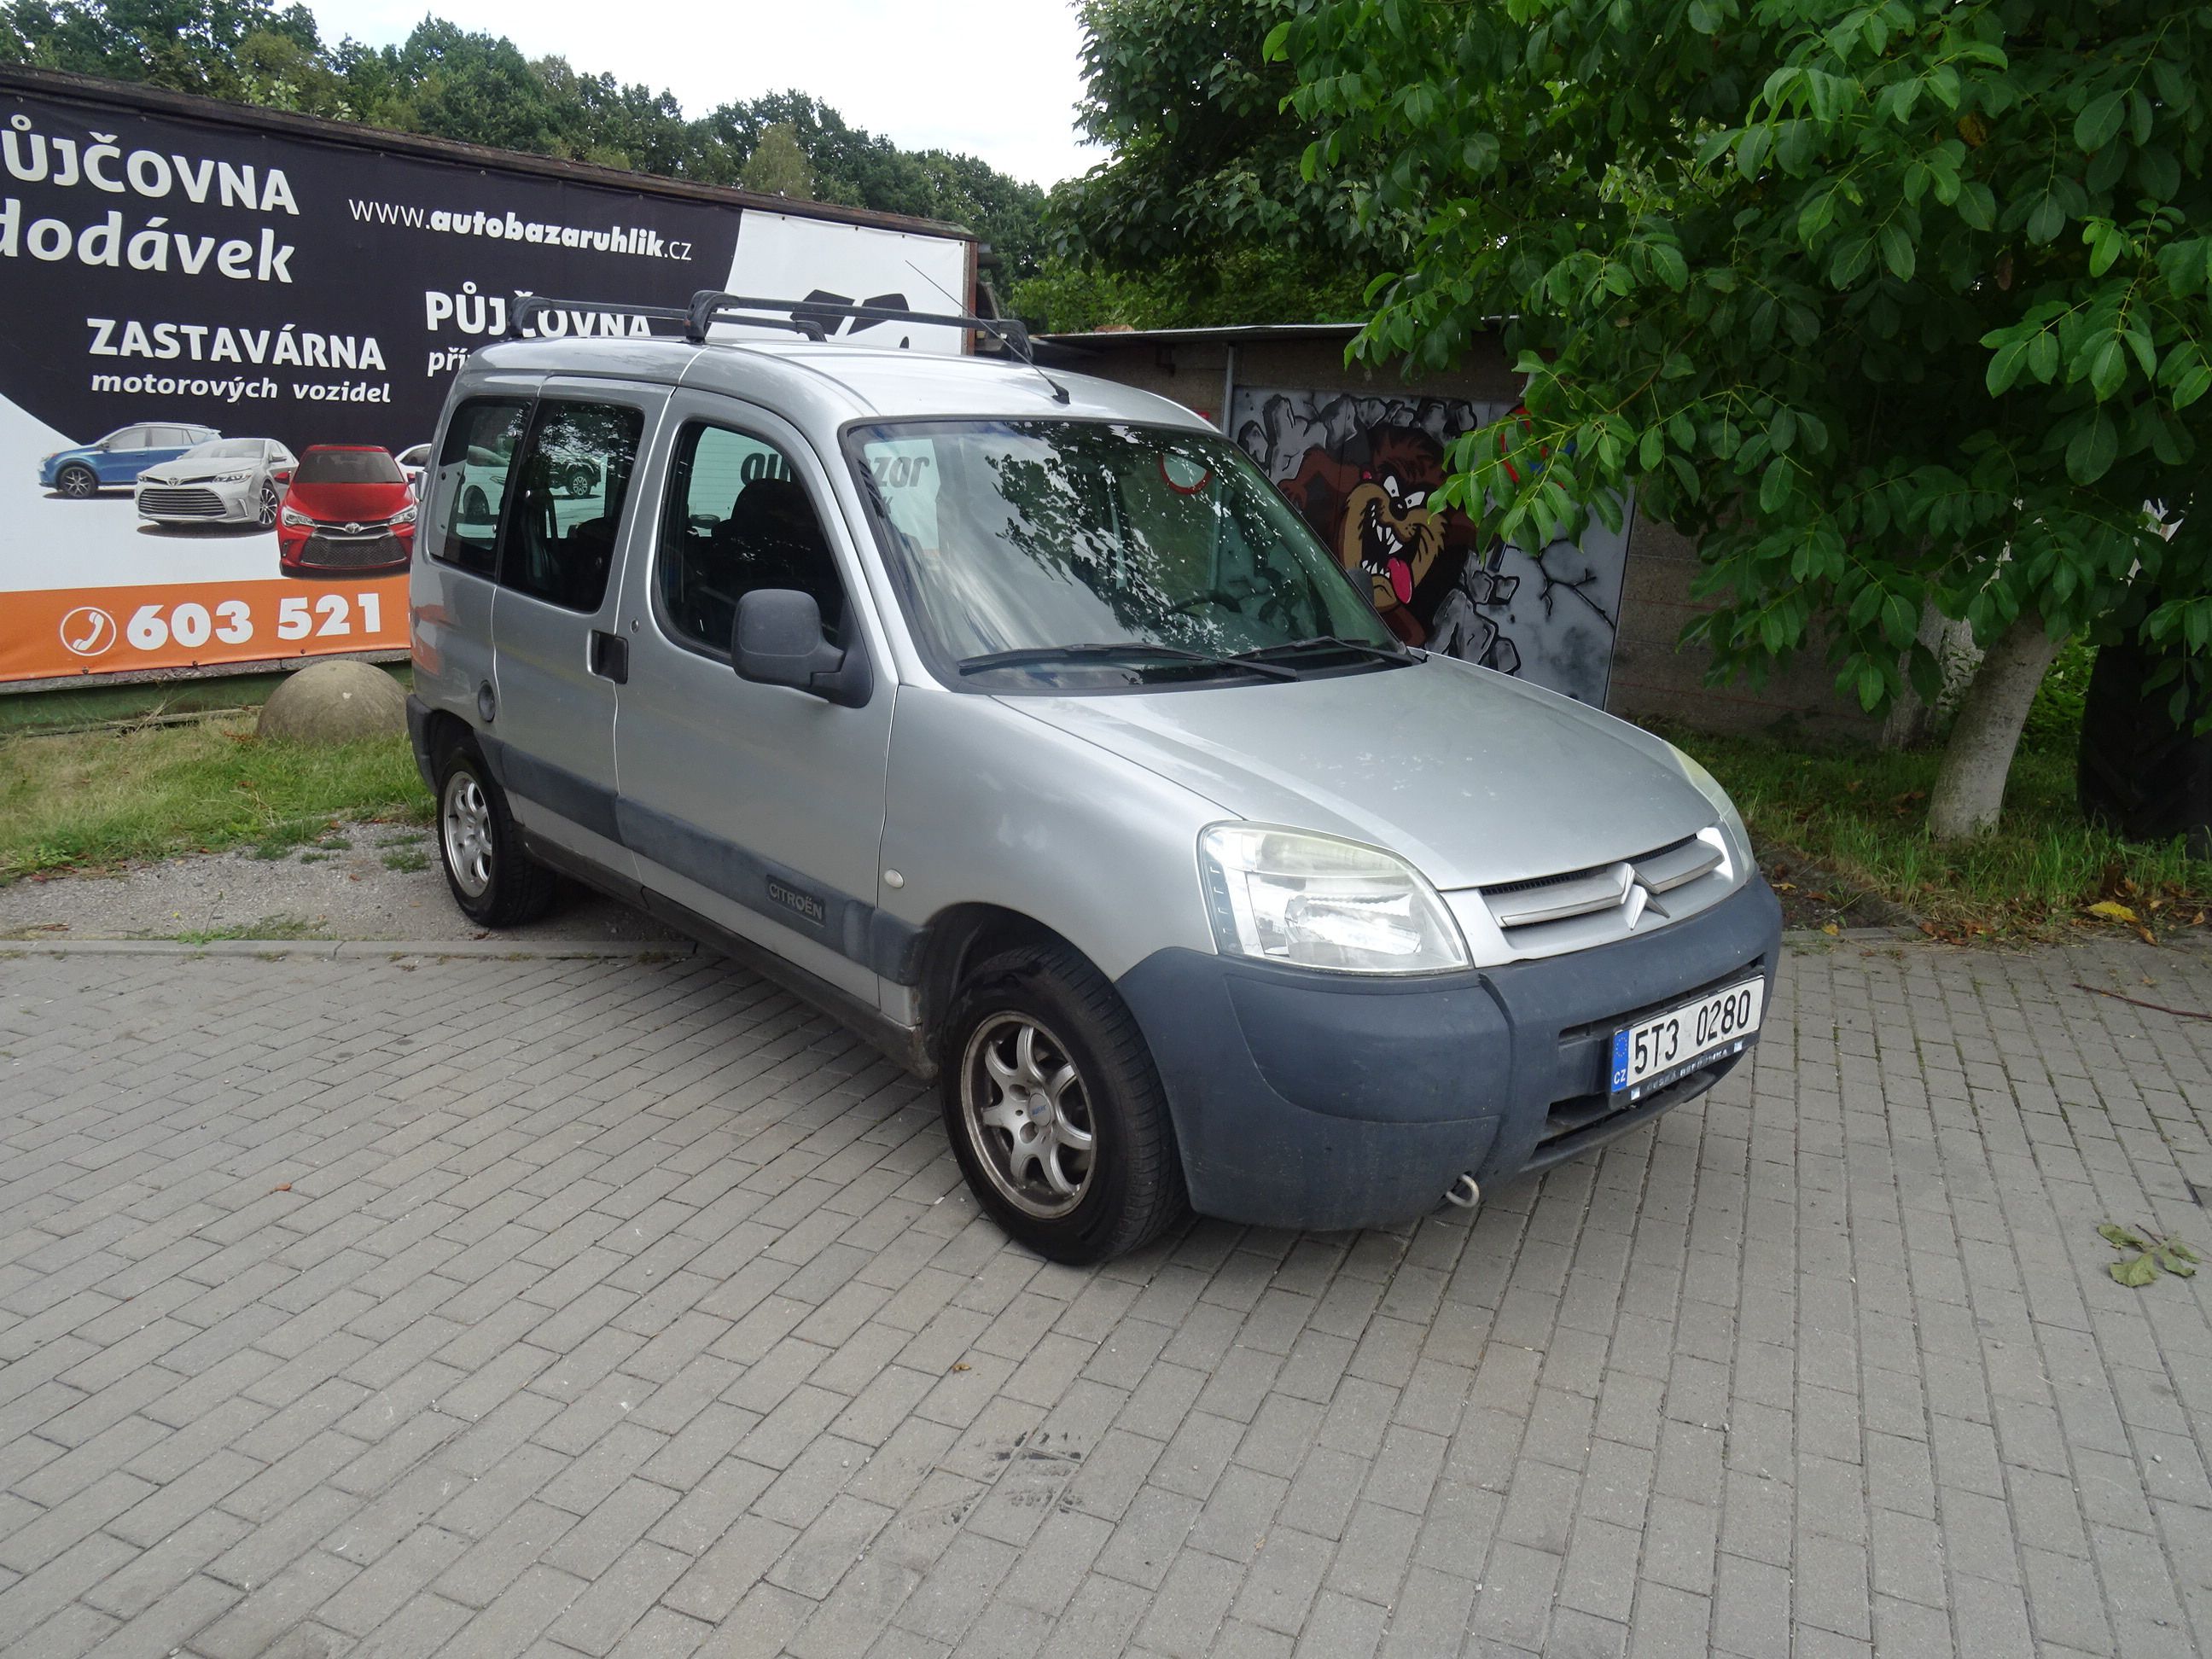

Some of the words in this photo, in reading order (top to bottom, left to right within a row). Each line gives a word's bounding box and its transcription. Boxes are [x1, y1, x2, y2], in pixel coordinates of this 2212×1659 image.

[348, 198, 692, 261] www.autobazaruhlik.cz
[425, 281, 652, 339] PŮJOVNA
[87, 317, 387, 370] ZASTAVÁRNA
[91, 373, 278, 405] motorových
[294, 379, 391, 404] vozidel
[126, 599, 253, 650] 603
[277, 592, 381, 640] 521
[769, 884, 823, 920] CITROËN
[1634, 1018, 1679, 1074] 5T3
[1696, 989, 1751, 1046] 0280
[1613, 1067, 1627, 1085] CZ
